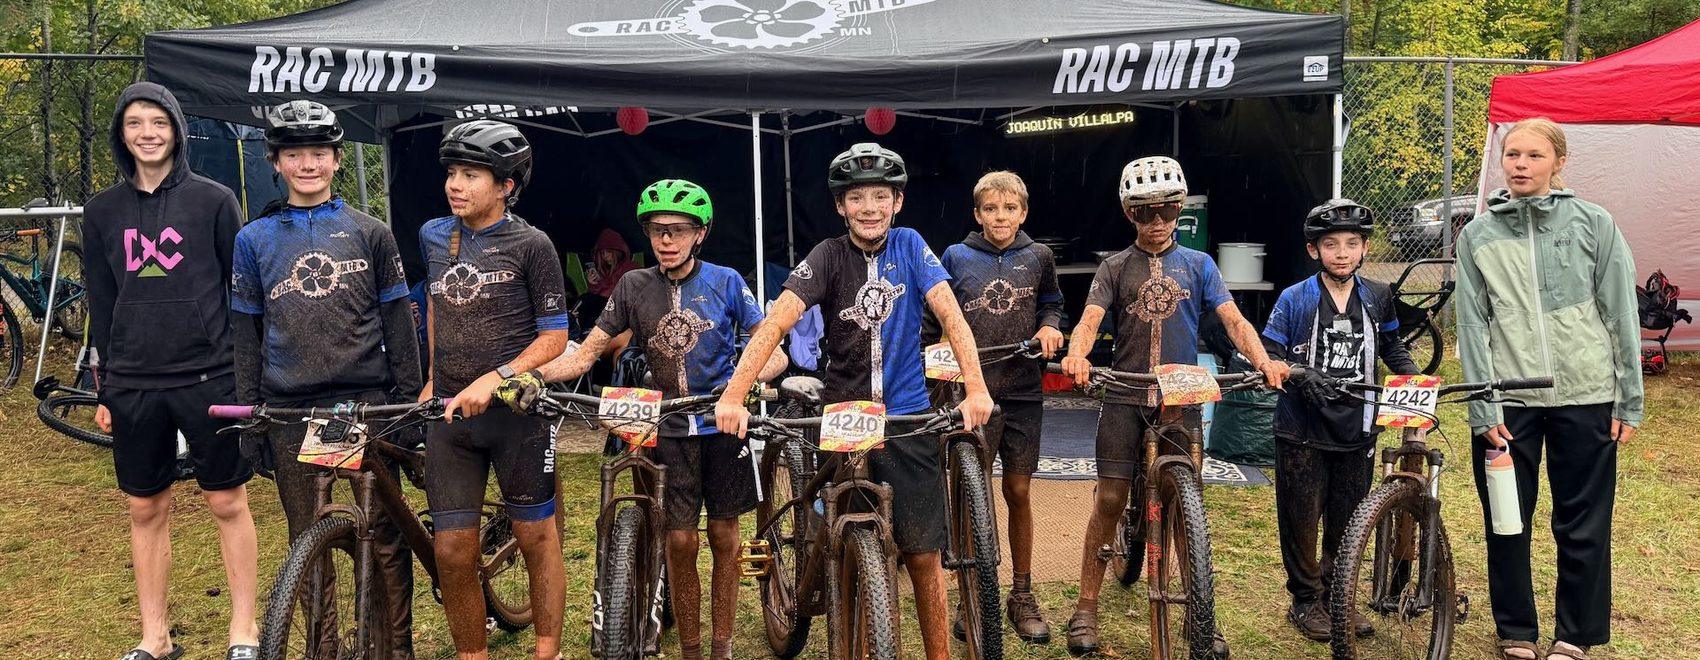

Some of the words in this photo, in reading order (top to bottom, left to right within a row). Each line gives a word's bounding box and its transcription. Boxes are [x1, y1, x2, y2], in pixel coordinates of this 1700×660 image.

[616, 20, 671, 34] RAC
[840, 27, 872, 37] MN
[248, 45, 335, 93] RAC
[339, 49, 437, 92] MTB
[1052, 42, 1141, 94] RAC
[1141, 37, 1241, 91] MTB
[932, 350, 956, 363] 42
[1330, 354, 1357, 369] MTB
[1387, 389, 1431, 406] 4242
[606, 402, 653, 420] 4239
[828, 413, 878, 432] 4240
[543, 448, 555, 473] RAC
